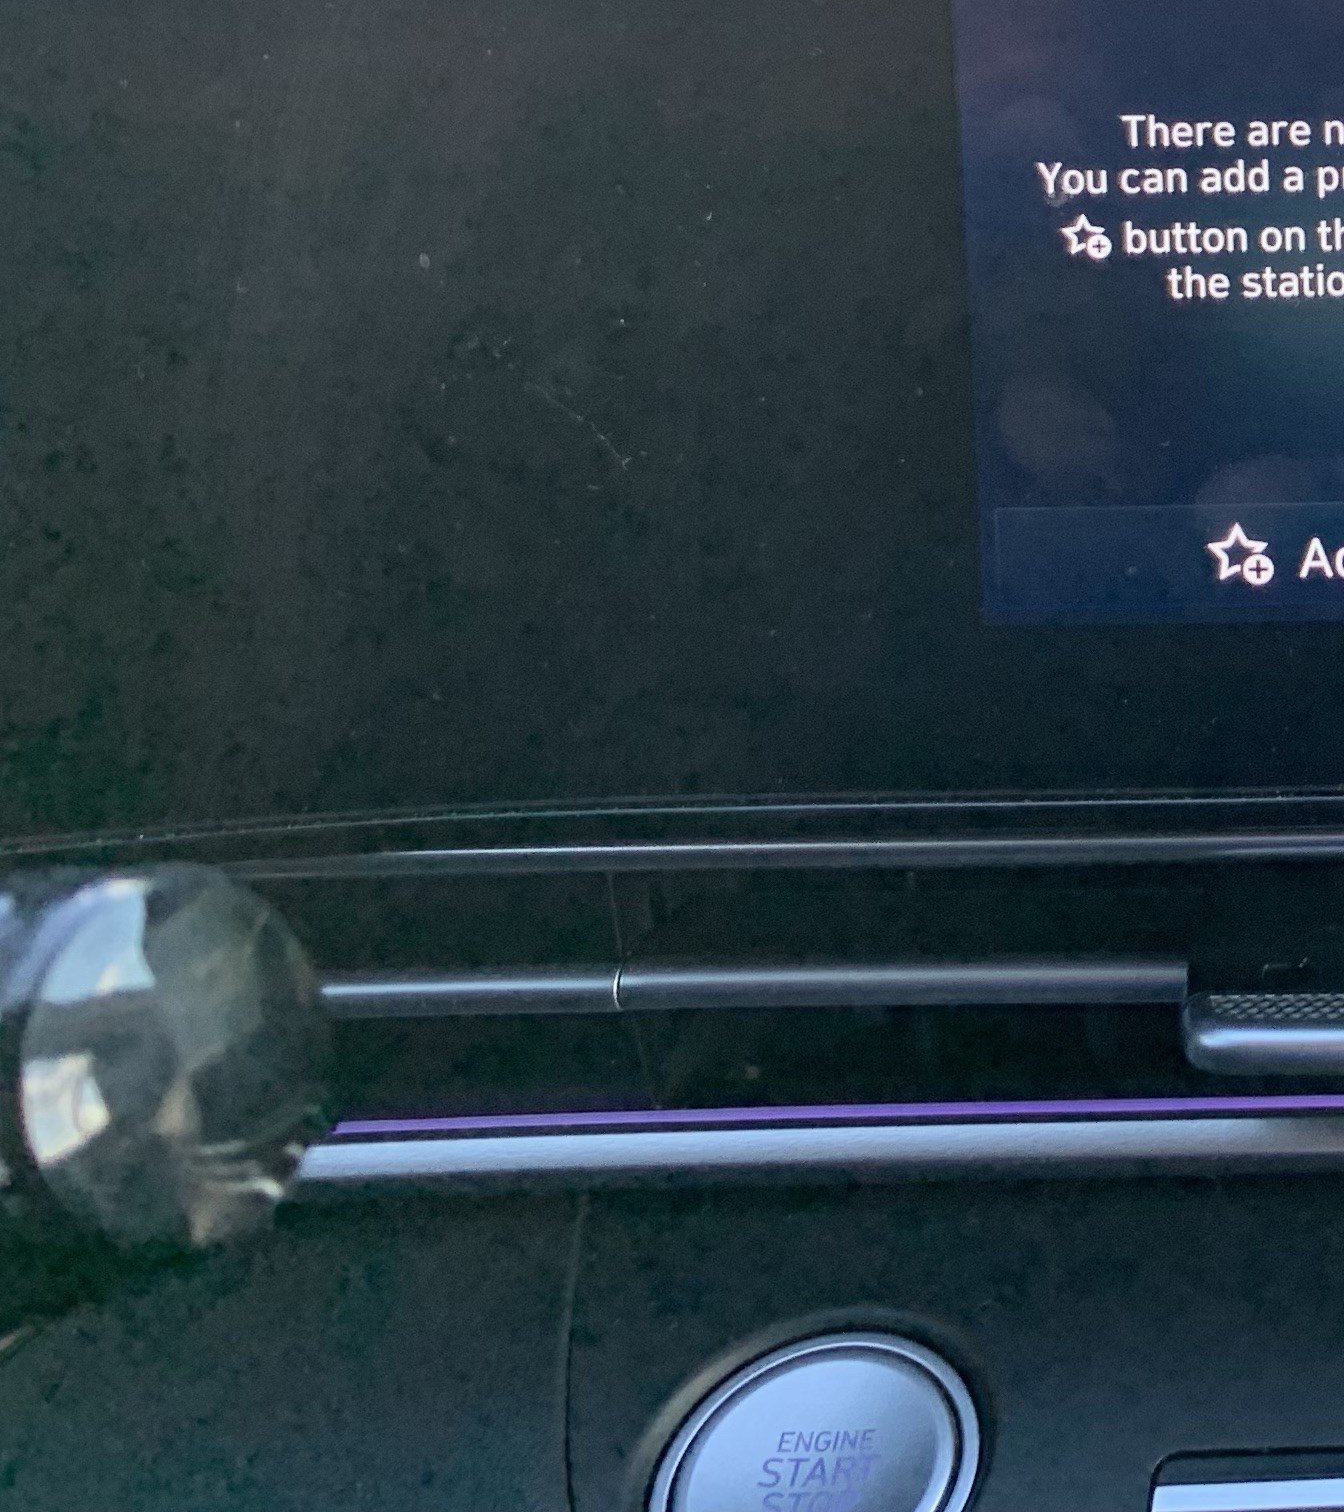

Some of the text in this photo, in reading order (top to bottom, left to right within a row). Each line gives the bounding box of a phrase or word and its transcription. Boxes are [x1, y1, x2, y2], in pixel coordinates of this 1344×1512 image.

[1119, 113, 1236, 149] There
[1247, 120, 1312, 147] are
[1035, 161, 1108, 196] You
[1118, 167, 1188, 195] can
[1199, 158, 1270, 194] add
[1282, 165, 1305, 193] a
[1123, 220, 1248, 255] button
[1260, 226, 1306, 253] on
[1166, 264, 1231, 300] the
[775, 1427, 881, 1455] ENGINE
[755, 1453, 883, 1489] START
